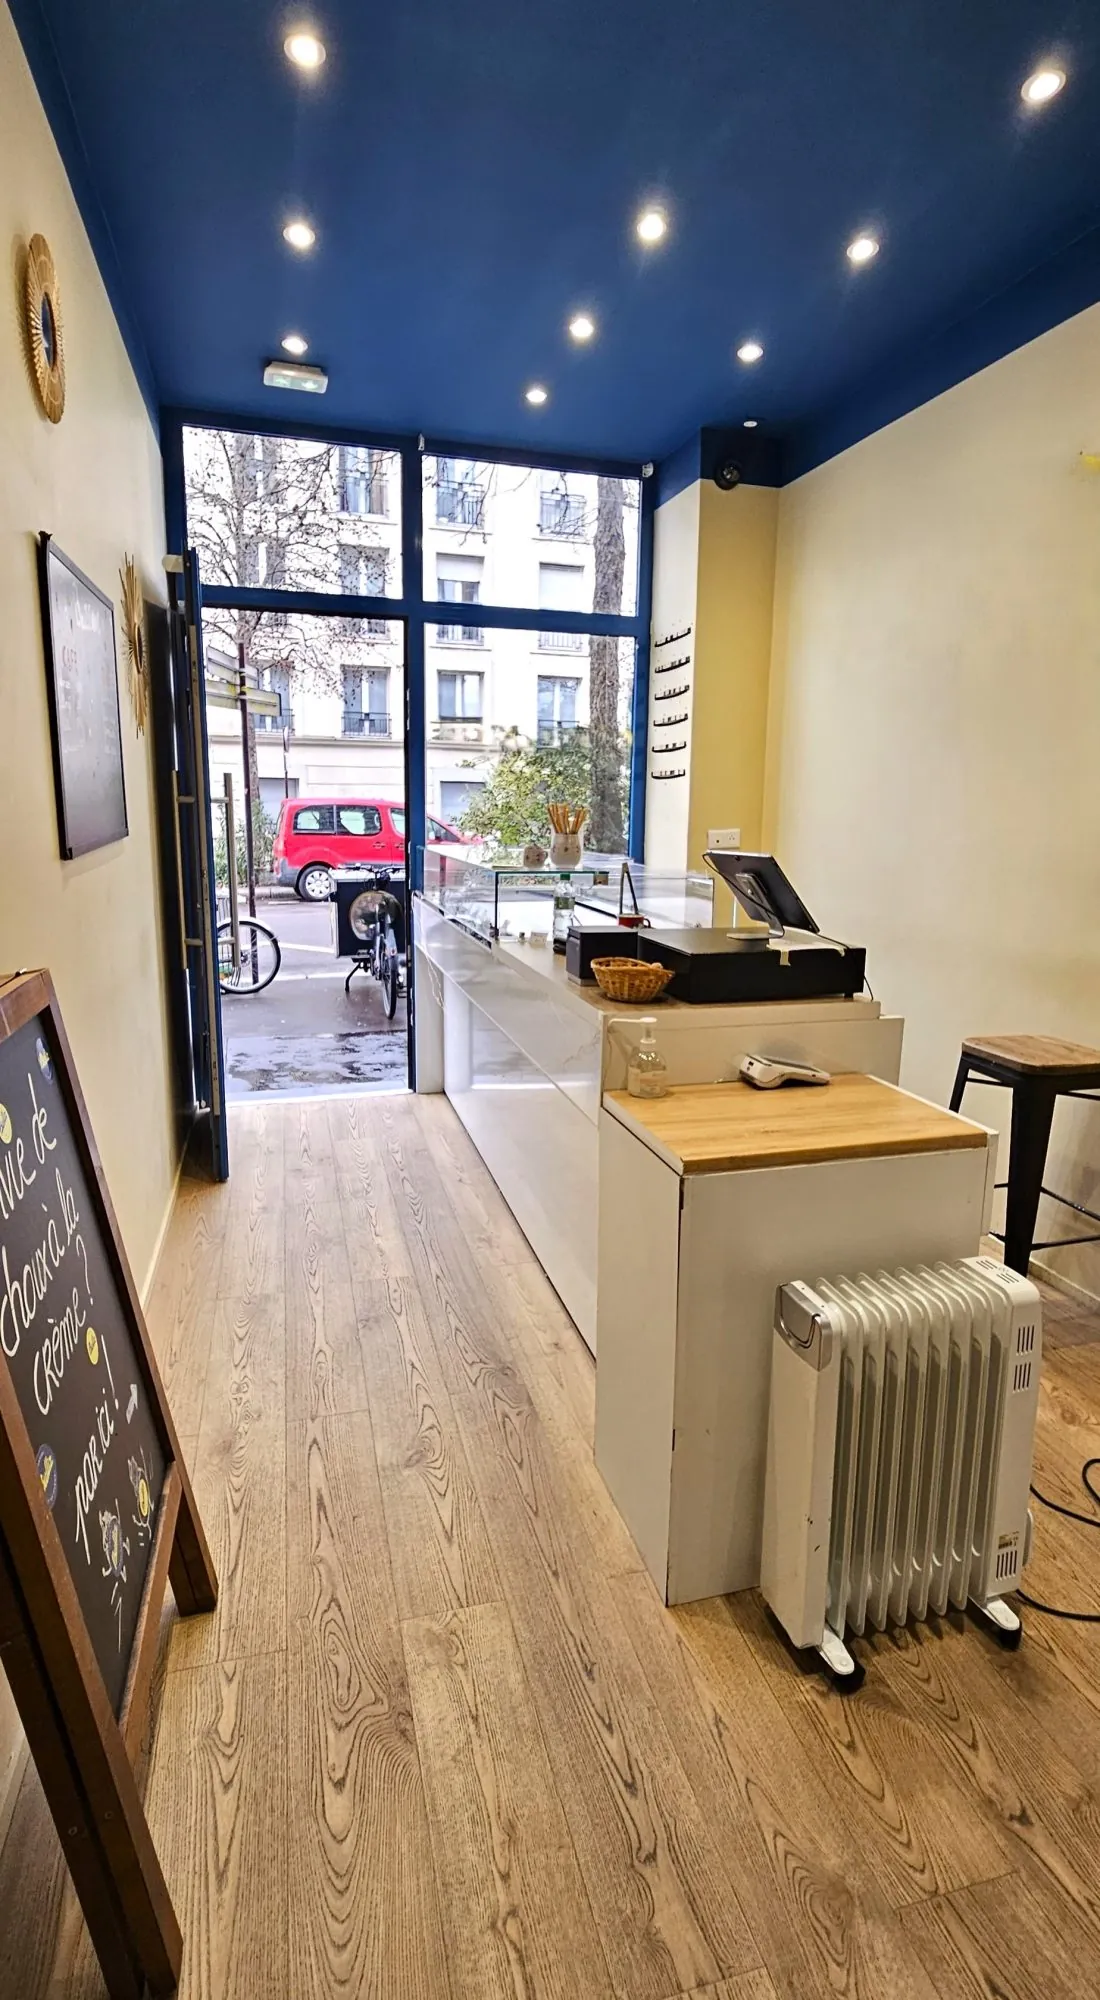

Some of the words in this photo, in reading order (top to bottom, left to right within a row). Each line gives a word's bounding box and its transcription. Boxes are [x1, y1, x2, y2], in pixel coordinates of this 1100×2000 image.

[28, 1072, 57, 1165] de
[0, 1240, 53, 1358] choux
[42, 1203, 65, 1268] à
[55, 1167, 80, 1247] la
